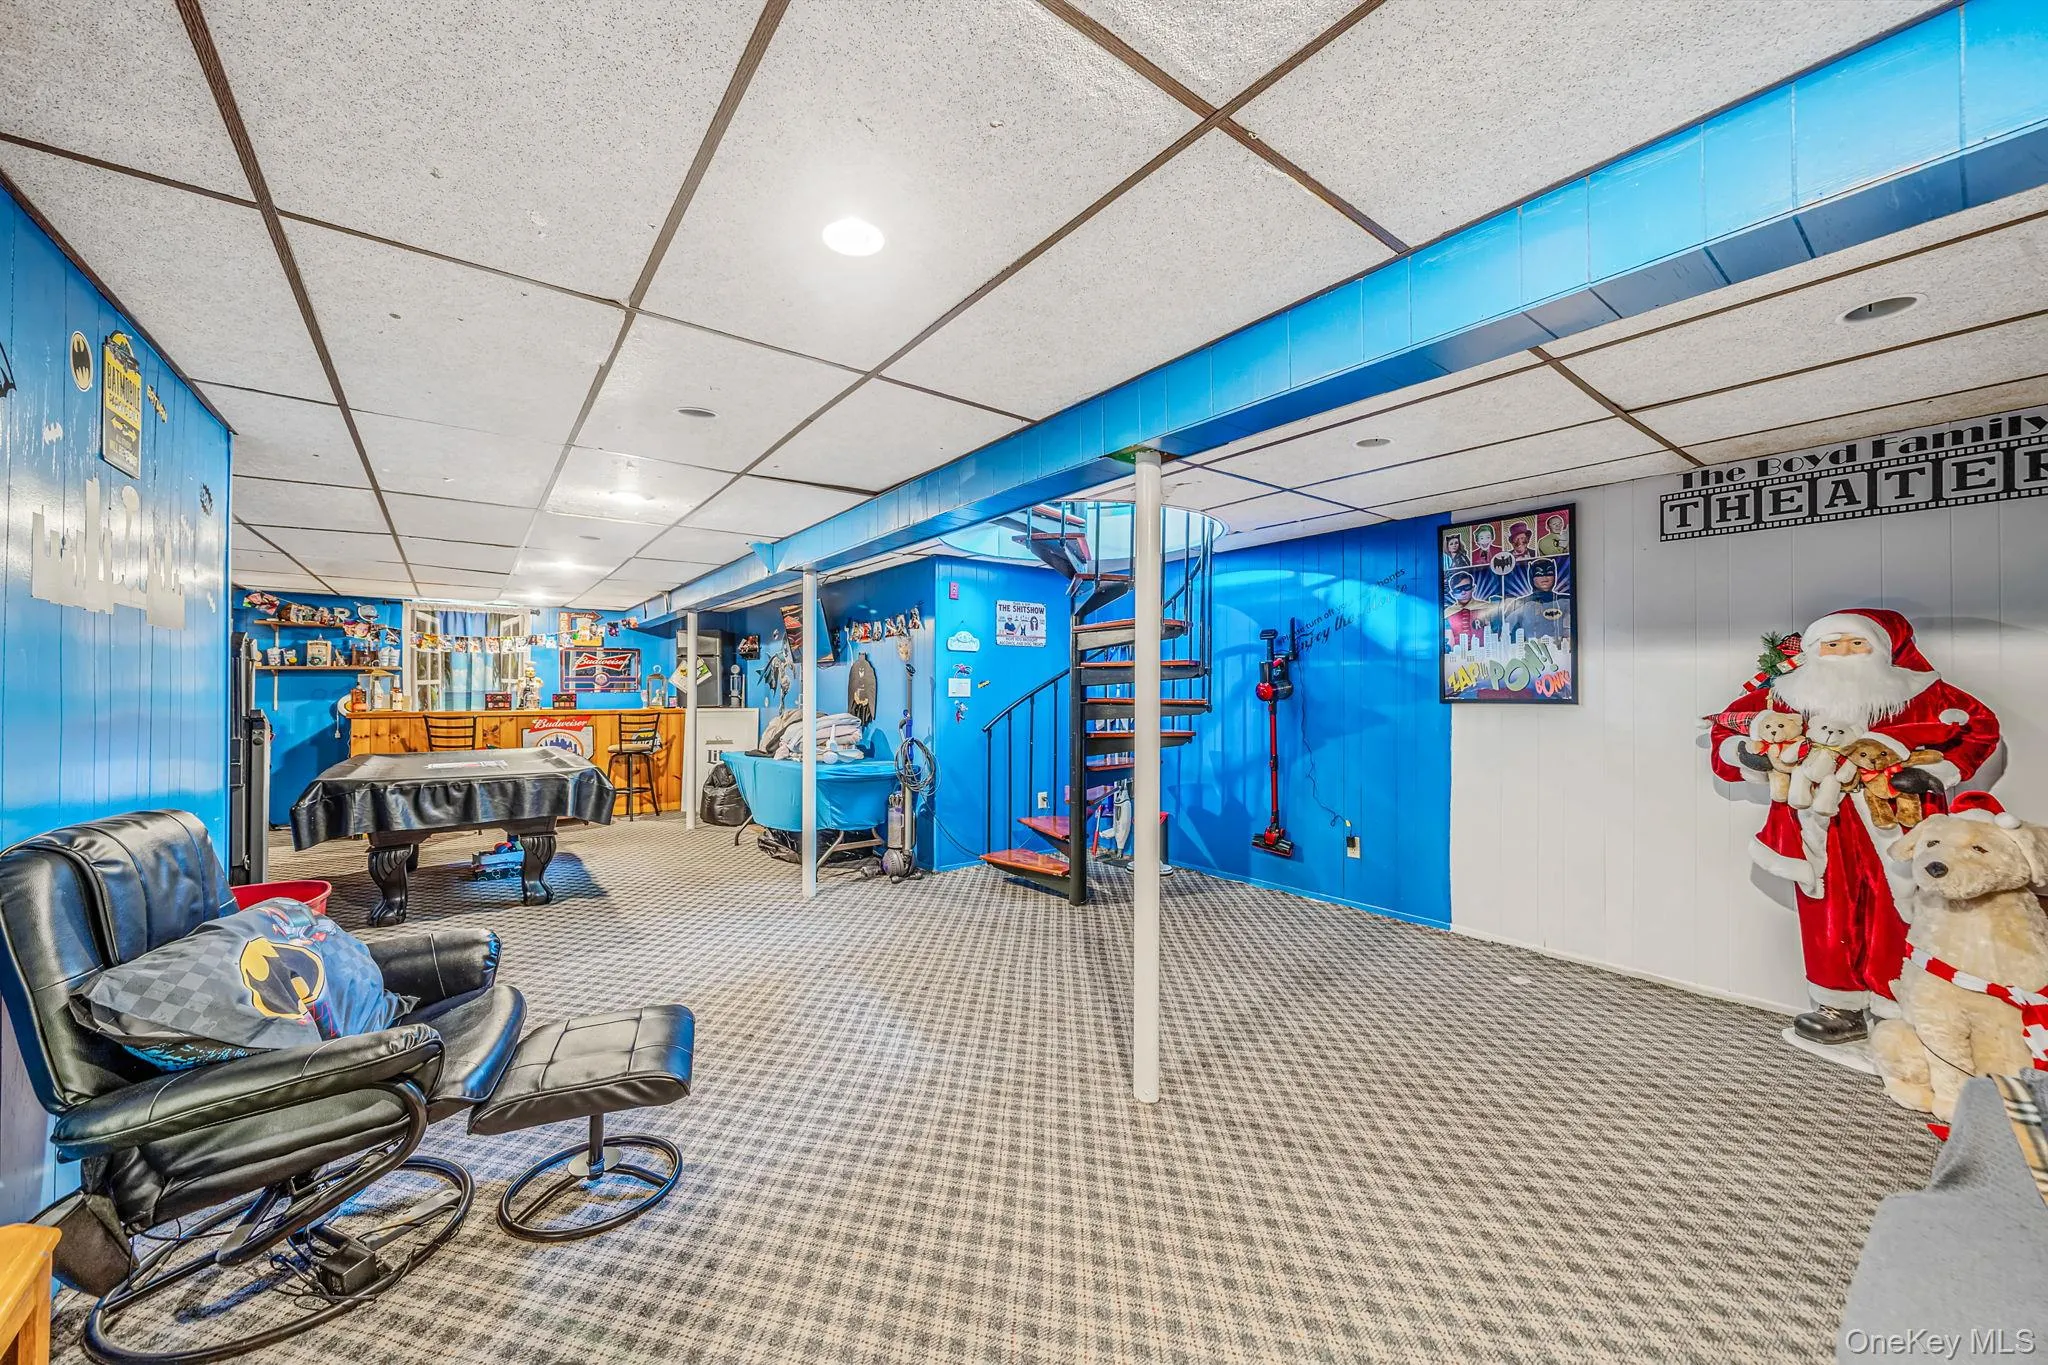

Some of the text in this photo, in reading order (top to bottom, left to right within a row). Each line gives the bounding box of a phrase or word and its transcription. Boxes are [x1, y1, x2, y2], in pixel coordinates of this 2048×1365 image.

[1677, 415, 2048, 490] The Boyd Family
[1305, 616, 1322, 629] turn
[1375, 568, 1405, 588] hones
[998, 604, 1045, 614] THE SHITSHOW
[575, 653, 629, 667] Budweiser
[533, 717, 588, 730] Budweiser
